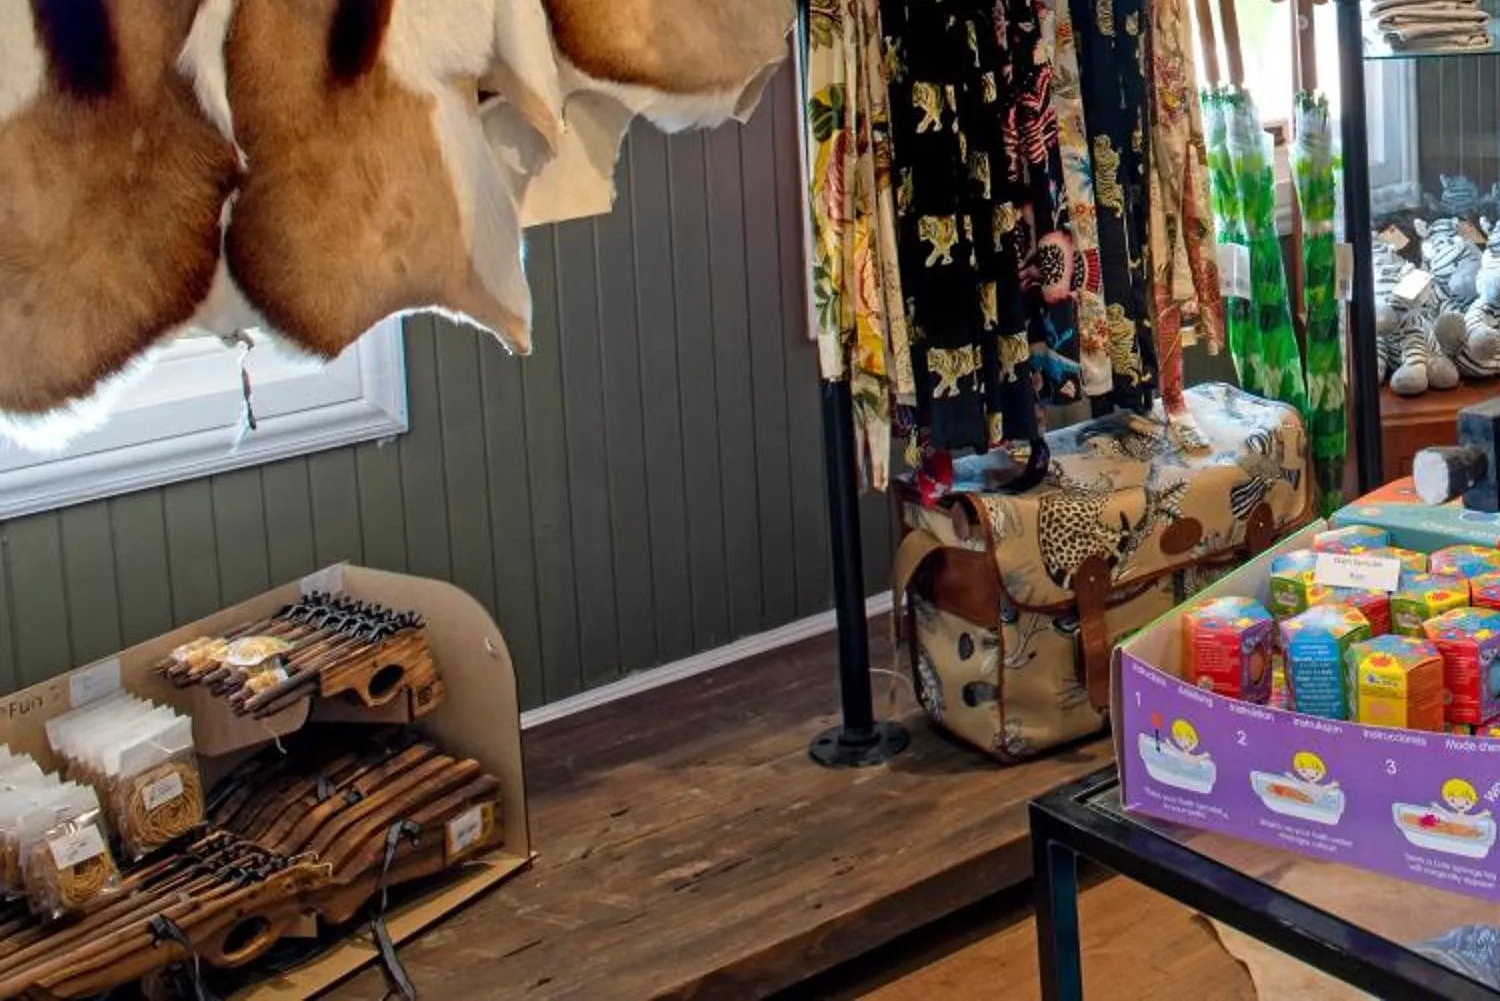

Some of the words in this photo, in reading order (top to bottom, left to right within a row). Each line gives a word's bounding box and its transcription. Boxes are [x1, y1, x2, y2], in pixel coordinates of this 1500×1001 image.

[1236, 730, 1248, 746] 2
[1445, 739, 1477, 753] Mode
[1385, 758, 1397, 775] 3
